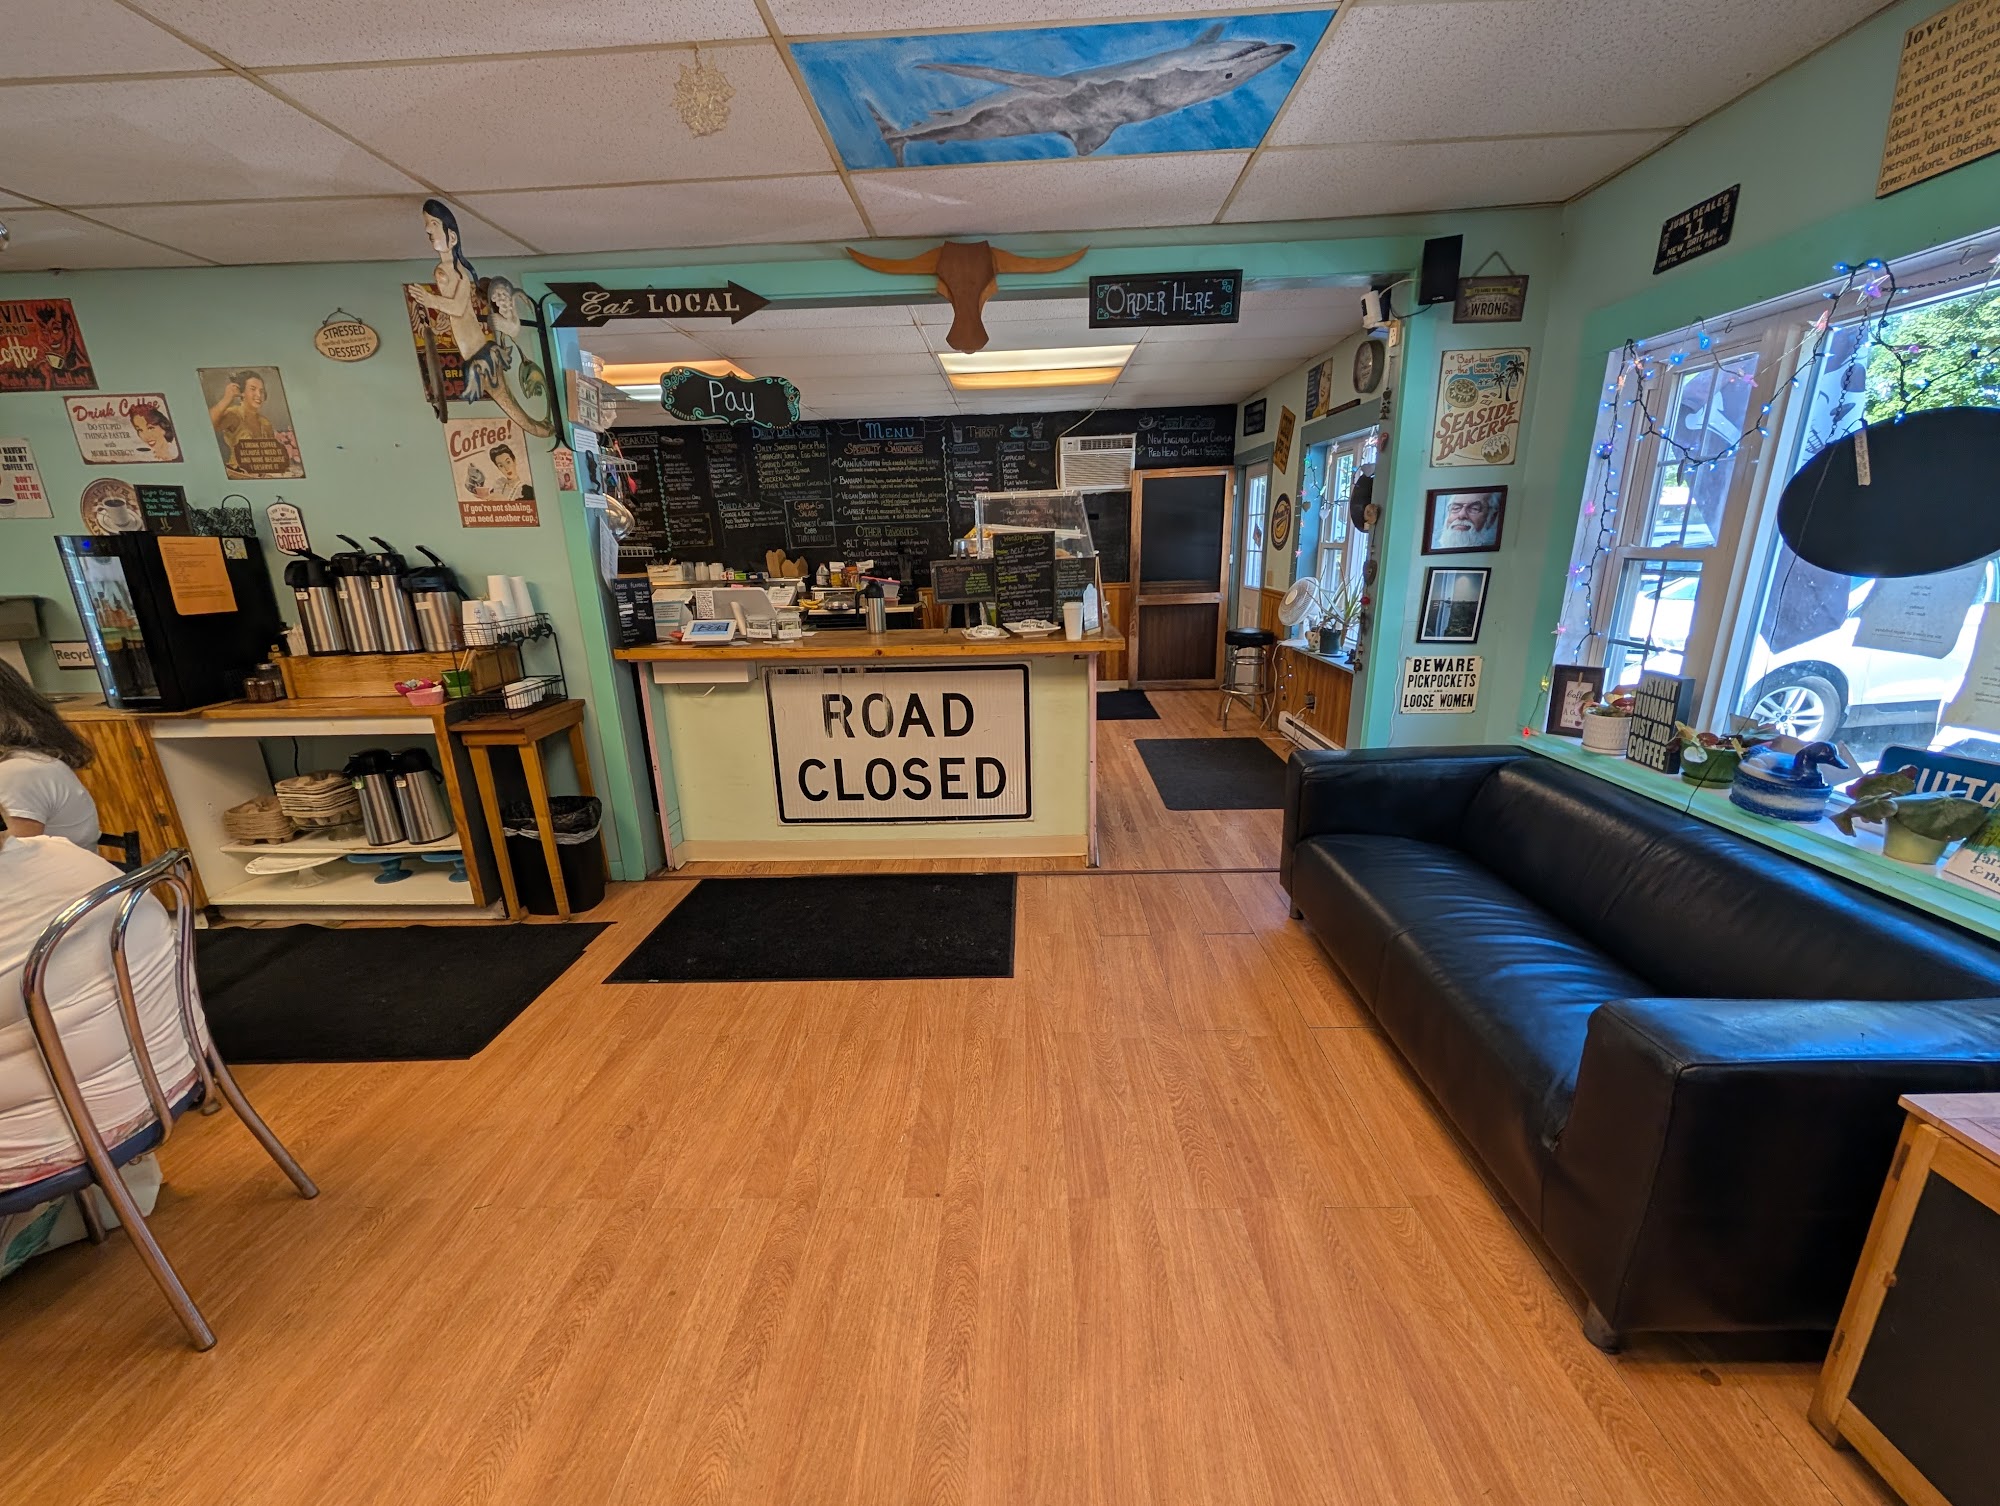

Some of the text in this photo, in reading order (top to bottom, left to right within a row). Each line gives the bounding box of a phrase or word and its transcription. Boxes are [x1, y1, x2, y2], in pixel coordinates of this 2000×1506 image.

[1903, 18, 1978, 65] something
[1905, 16, 1948, 50] love
[1894, 60, 1988, 113] ment or deep
[1897, 65, 1948, 97] of warm
[1891, 113, 1908, 129] for
[1886, 138, 1920, 158] whom
[1924, 124, 1950, 142] love
[1955, 117, 1964, 128] is
[1668, 212, 1691, 232] JUNK
[1693, 194, 1729, 219] DEALER
[1667, 227, 1720, 257] NEW BRITAIN
[581, 291, 740, 321] Eat LOCAL
[1105, 281, 1214, 316] ORDER HERE
[0, 305, 33, 323] VIL
[1471, 302, 1508, 315] WRONG
[323, 325, 366, 339] STRESSED
[328, 343, 371, 357] DESSERTS
[1456, 354, 1494, 363] Best buns
[1458, 365, 1468, 374] the
[708, 380, 755, 420] Pay
[73, 398, 160, 421] Drink Coffee
[1436, 400, 1518, 438] SEASIDE
[450, 420, 512, 457] Coffee!
[607, 431, 659, 447] BREAKFAST
[777, 428, 795, 438] DELI
[865, 422, 915, 439] MENU
[1148, 433, 1162, 444] NEW
[1163, 432, 1190, 445] ENGLAND
[1191, 432, 1209, 443] CLAM
[1436, 416, 1519, 461] BAKERY
[844, 441, 924, 455] SPECIALTY SANDWICHES
[1181, 445, 1203, 457] CHILI
[24, 463, 35, 471] YET
[841, 492, 859, 500] VEGAN
[492, 504, 503, 513] not
[464, 513, 477, 524] you
[478, 512, 494, 523] need
[495, 511, 520, 523] another
[804, 527, 818, 535] COBB
[856, 525, 919, 537] OTHER FAVORITES
[277, 534, 306, 549] COFFEE
[846, 539, 859, 548] BLT
[1413, 658, 1475, 672] BEWARE
[1407, 674, 1476, 688] PICKPOCKETS
[1637, 677, 1678, 701] INSTANT
[1404, 694, 1474, 707] LOOSE WOMEN
[1634, 693, 1675, 725] HUMAN
[822, 693, 975, 738] ROAD
[1630, 716, 1670, 745] JUST ADD
[1627, 735, 1667, 770] COFFEE
[798, 757, 1007, 801] CLOSED
[1915, 767, 2000, 809] UTTA
[1973, 851, 2000, 868] far
[1970, 865, 1984, 875] &
